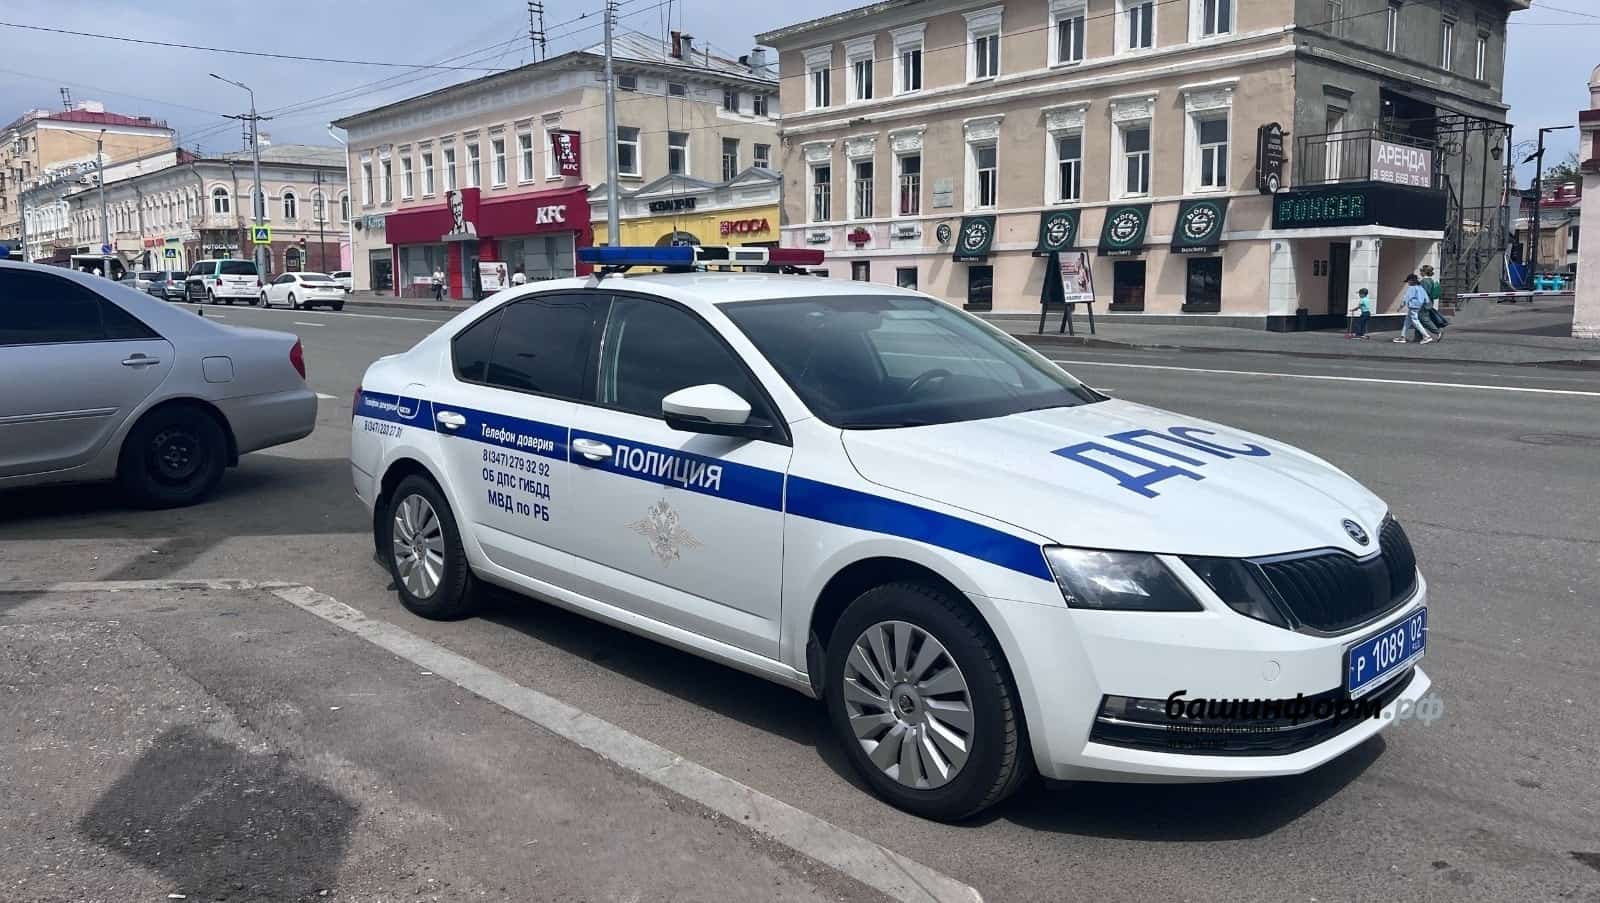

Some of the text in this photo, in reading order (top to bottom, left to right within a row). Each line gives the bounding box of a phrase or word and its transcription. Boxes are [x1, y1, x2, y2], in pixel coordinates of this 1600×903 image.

[1377, 144, 1426, 172] АРЕНДА
[536, 205, 566, 225] KFC
[731, 218, 770, 234] КОСА
[481, 423, 554, 451] Телефон доверия
[526, 459, 537, 474] 32
[538, 462, 550, 477] 92
[614, 444, 723, 491] ПОЛИЦИЯ
[1050, 426, 1271, 498] ДПС
[482, 467, 551, 501] ОБ ДПС ГИБДД
[487, 489, 550, 522] МВД по РБ
[1357, 615, 1422, 682] Р 1089 02
